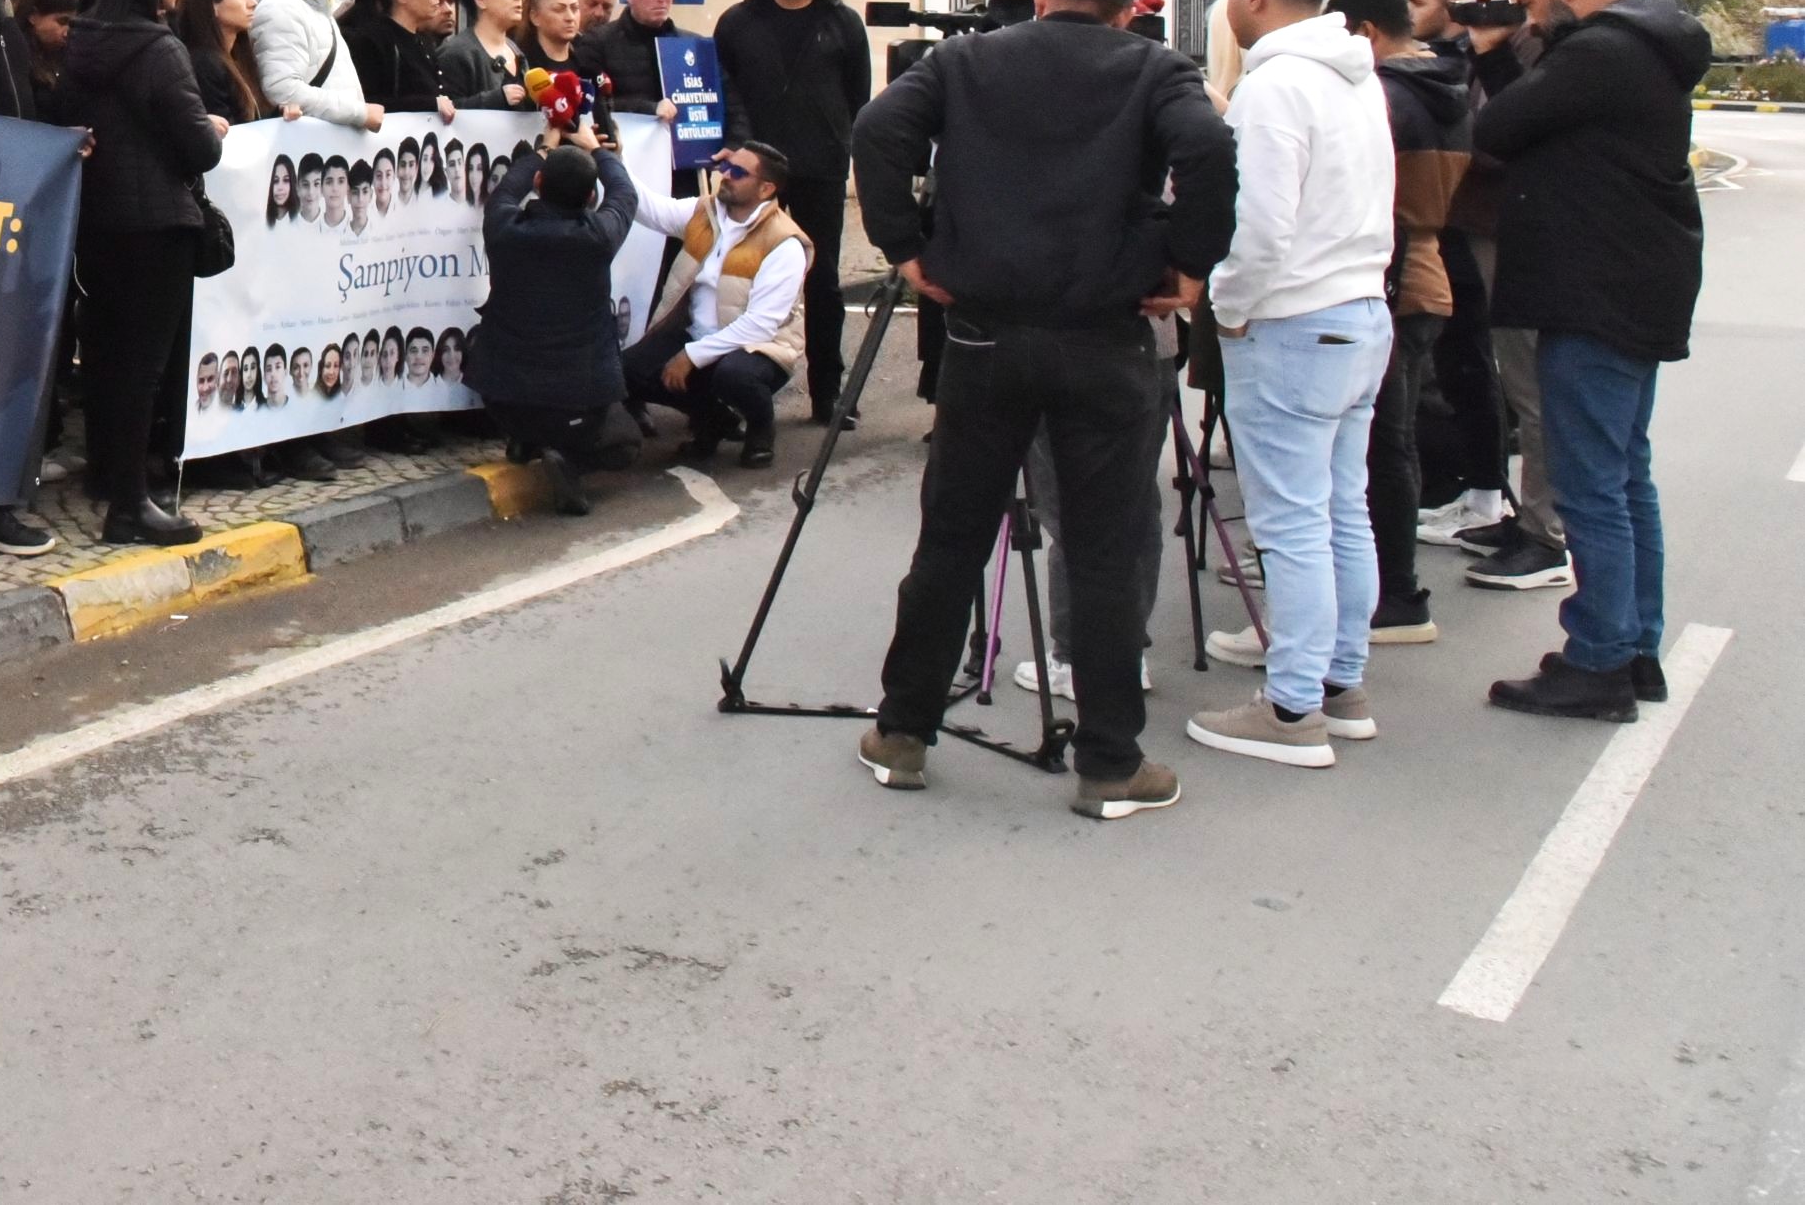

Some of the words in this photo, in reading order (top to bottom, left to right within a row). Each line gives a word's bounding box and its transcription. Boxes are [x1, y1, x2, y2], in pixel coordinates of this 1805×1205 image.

[683, 73, 704, 89] İSİAS
[671, 88, 718, 104] CİNAYETİNİN
[338, 247, 461, 303] Şampiyon
